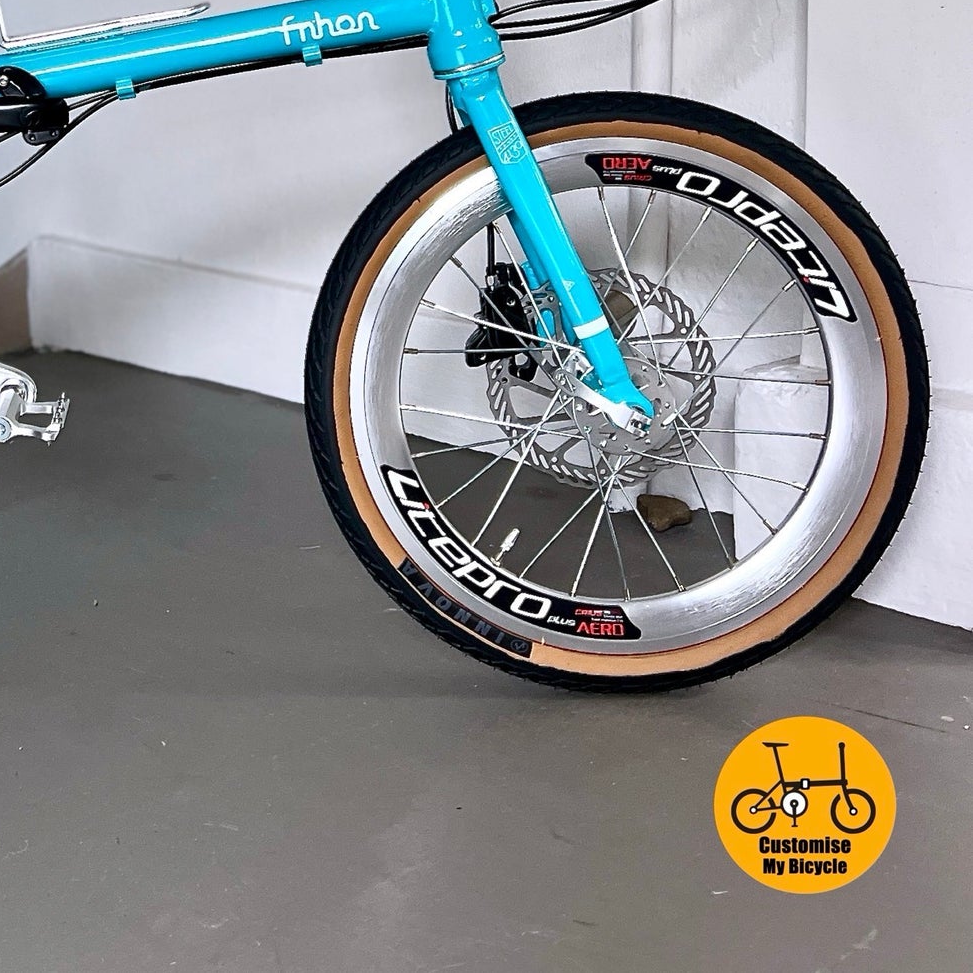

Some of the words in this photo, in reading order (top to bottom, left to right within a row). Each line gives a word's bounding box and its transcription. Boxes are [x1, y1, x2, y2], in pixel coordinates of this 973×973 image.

[603, 157, 652, 170] AERO
[676, 171, 850, 318] Litepro
[387, 470, 551, 618] Litepro
[402, 560, 505, 644] INNOVA
[577, 621, 625, 636] AERO
